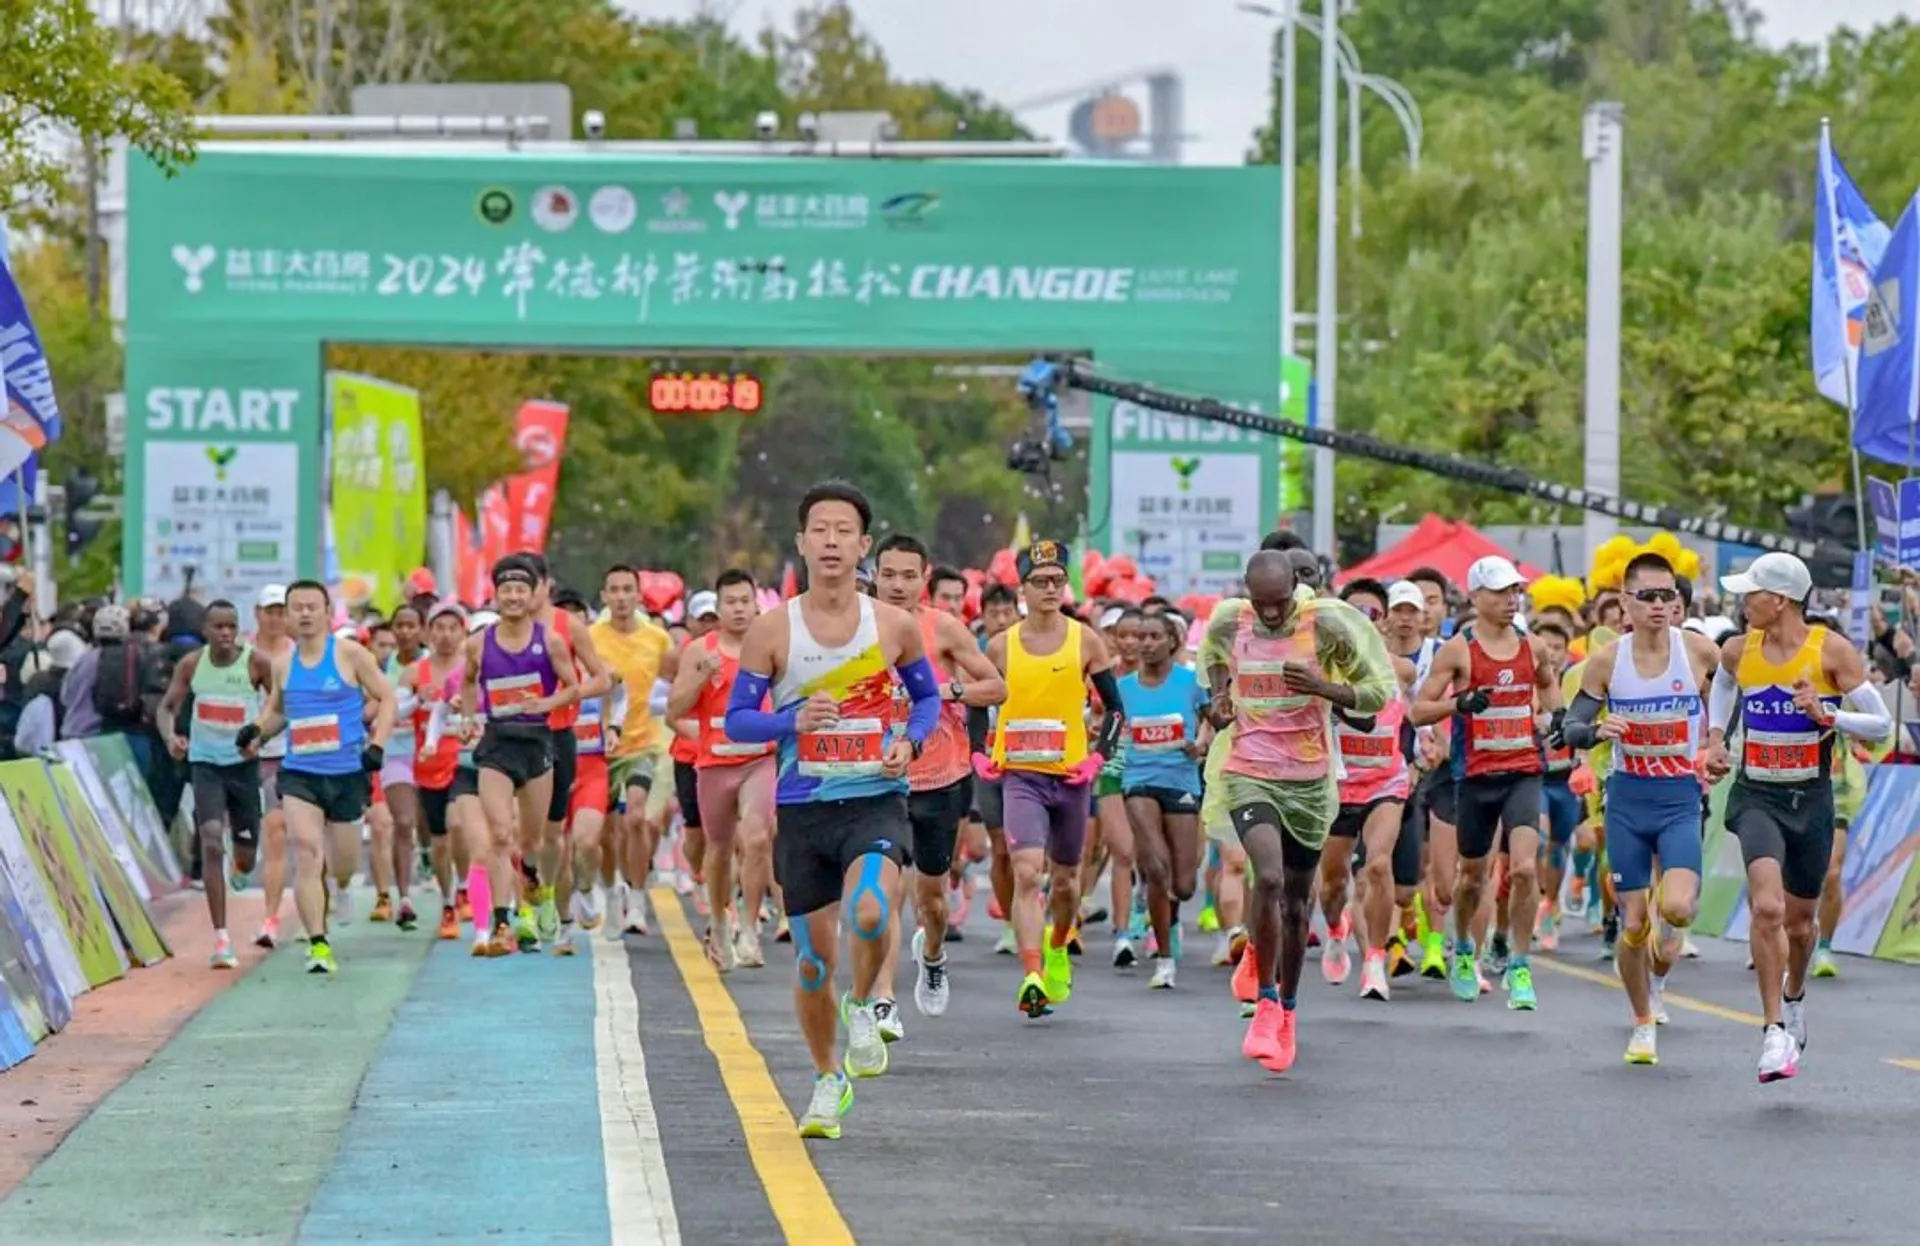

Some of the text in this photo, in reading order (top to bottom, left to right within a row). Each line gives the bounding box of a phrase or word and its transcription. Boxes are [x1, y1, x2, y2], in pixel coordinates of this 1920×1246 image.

[909, 264, 1134, 302] CHANGDE
[146, 388, 299, 430] START
[815, 738, 865, 756] A179
